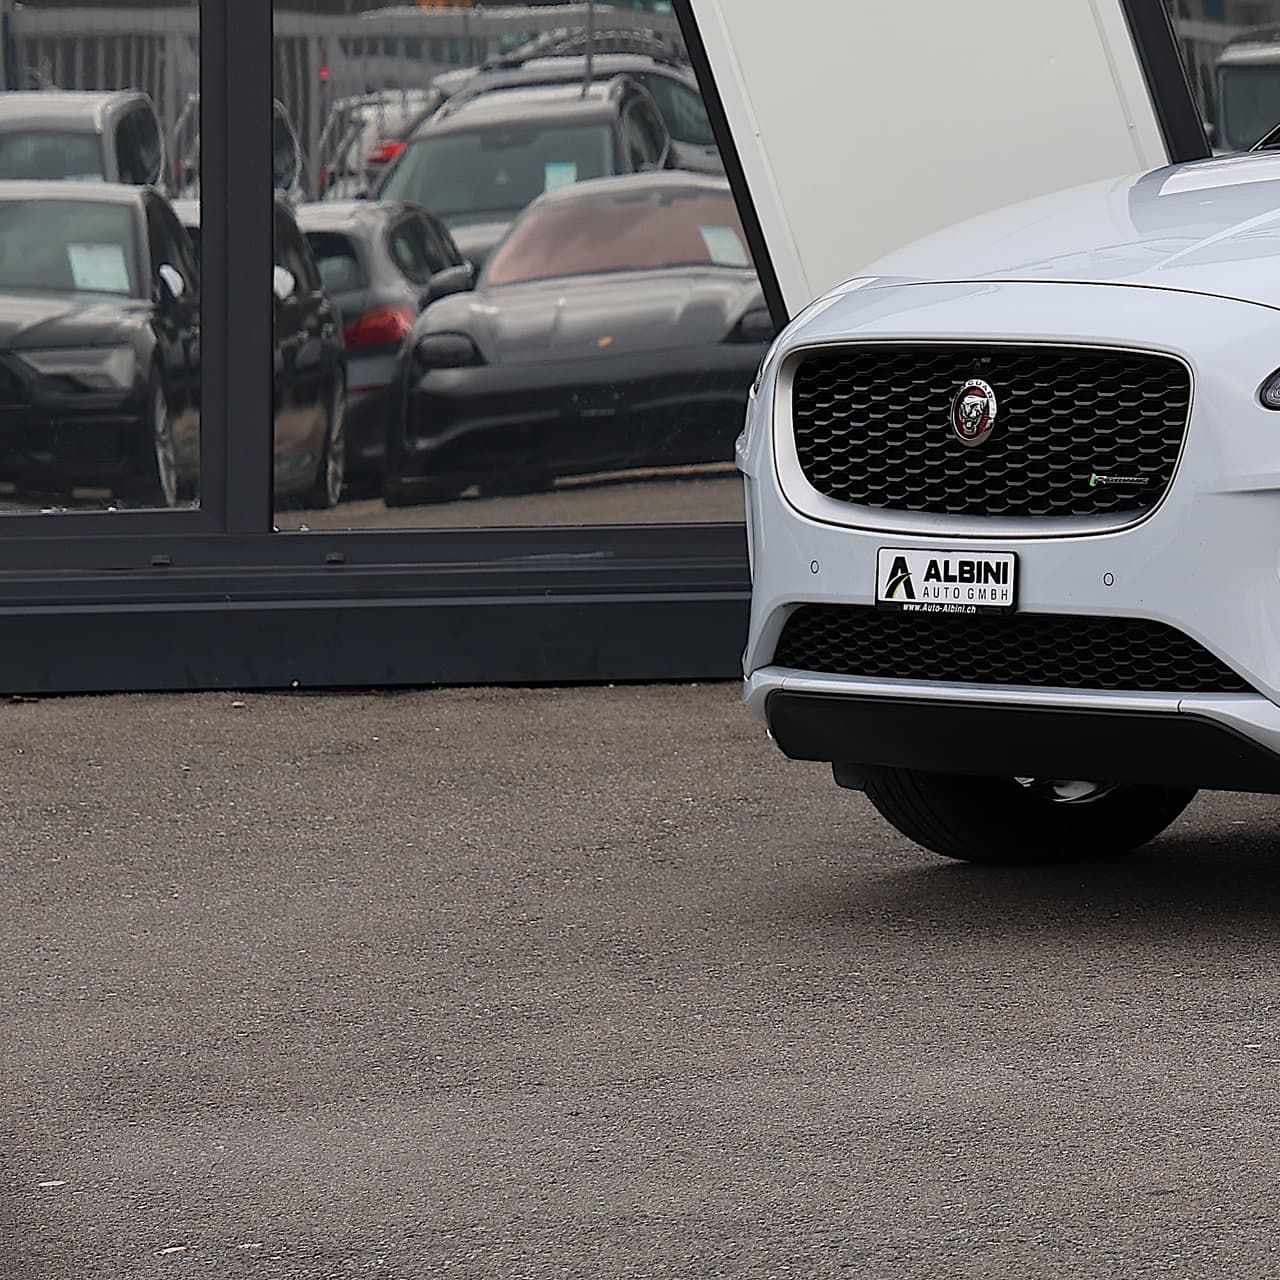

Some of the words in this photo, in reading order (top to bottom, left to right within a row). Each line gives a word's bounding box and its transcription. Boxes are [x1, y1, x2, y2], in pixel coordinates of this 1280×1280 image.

[923, 559, 1009, 585] ALBINI
[922, 586, 960, 600] AUTO
[967, 587, 1009, 601] GMBH
[903, 603, 977, 615] www.Auto-Albini.ch
